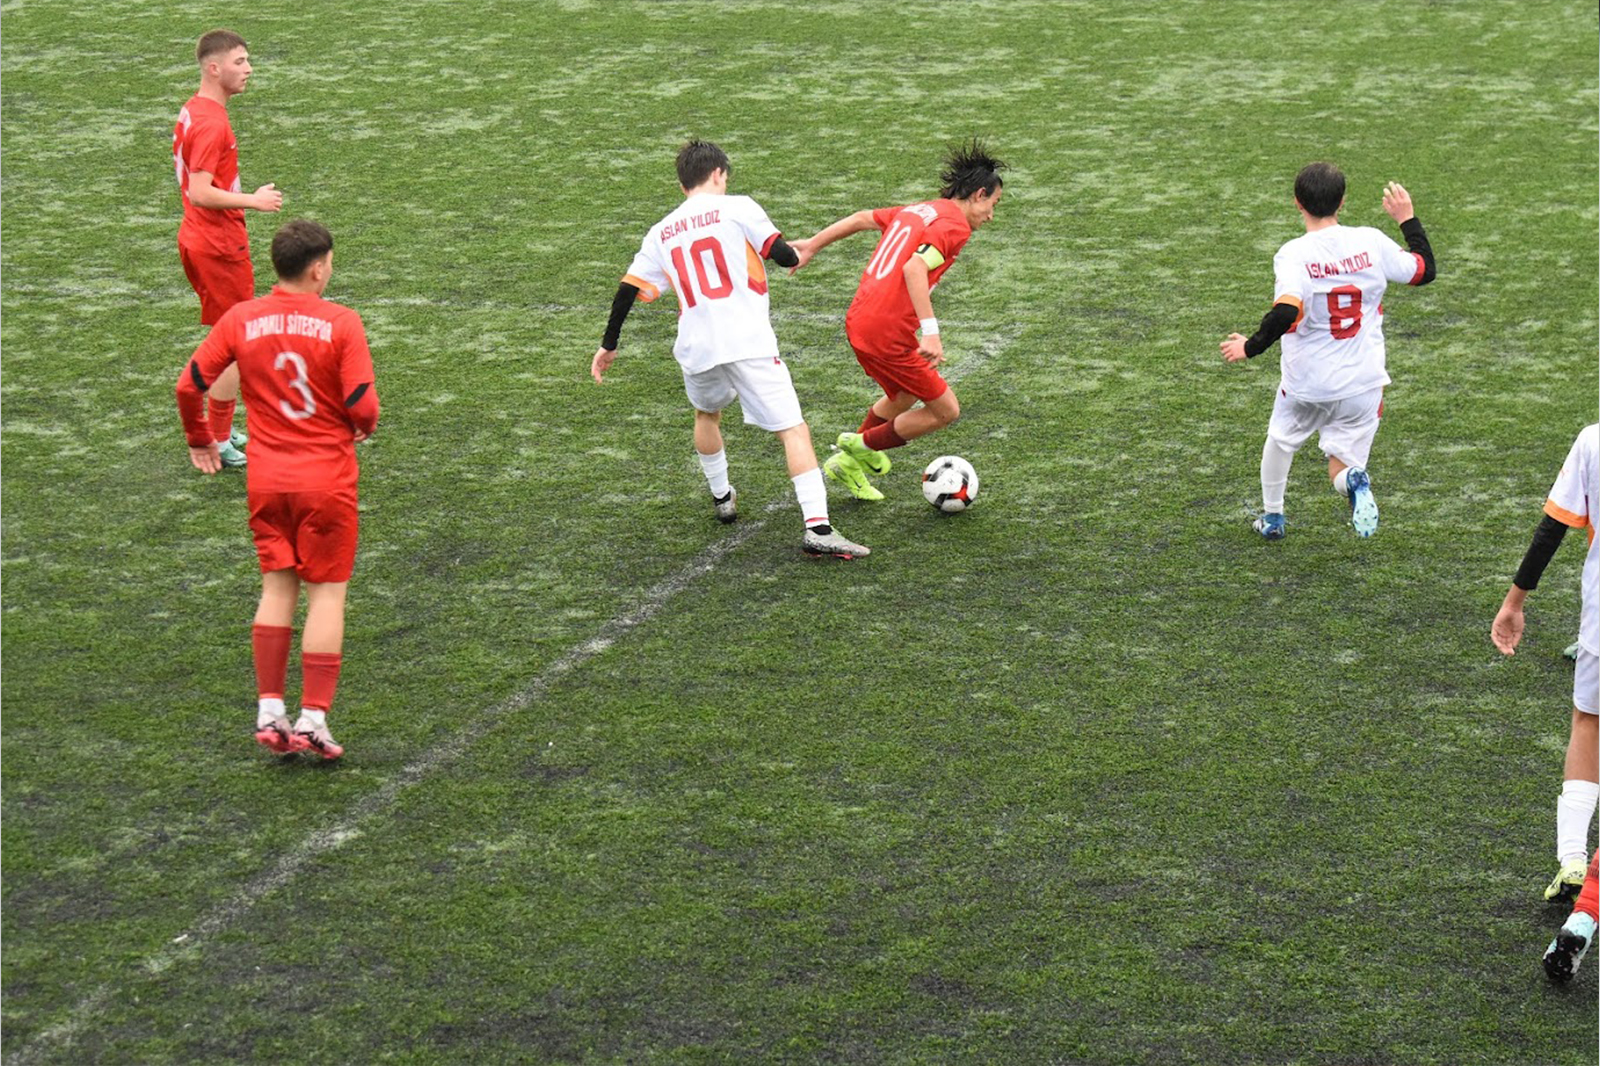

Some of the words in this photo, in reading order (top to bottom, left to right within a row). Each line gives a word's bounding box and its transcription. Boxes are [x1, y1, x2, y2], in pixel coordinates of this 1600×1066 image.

[660, 218, 688, 244] ASLAN
[690, 209, 721, 229] YILDIZ
[866, 220, 912, 280] 10
[670, 236, 734, 308] 10
[1339, 251, 1373, 274] YILDIZ
[286, 310, 333, 343] SİTESPOR
[1327, 284, 1364, 340] 8
[274, 351, 316, 420] 3
